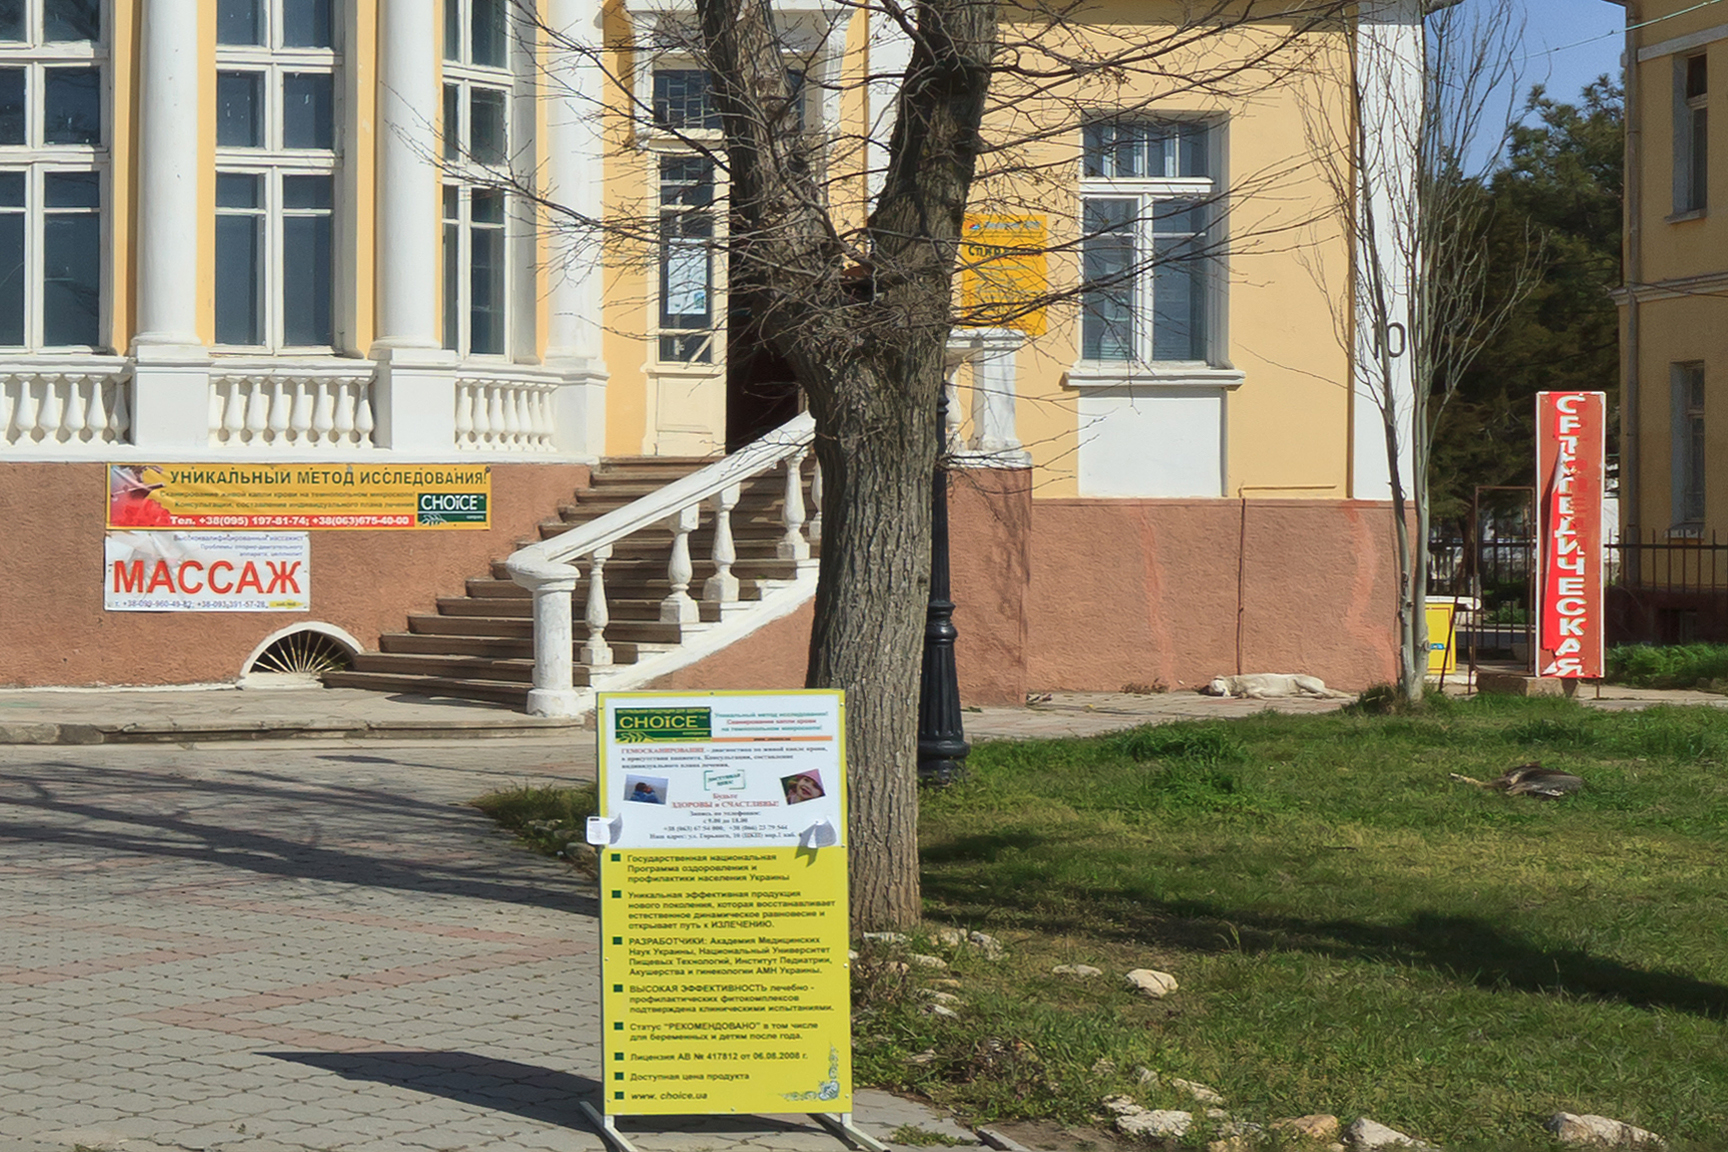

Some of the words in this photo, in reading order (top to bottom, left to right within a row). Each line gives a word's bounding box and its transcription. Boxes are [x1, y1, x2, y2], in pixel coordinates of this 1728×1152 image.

[298, 471, 355, 486] МЕТОД
[361, 471, 487, 486] ИССЛЕДОВАНИЯ!
[170, 516, 196, 524] Тел.
[199, 516, 248, 526] +38(095)
[114, 560, 302, 594] МАССАЖ
[628, 855, 707, 864] Государственная
[710, 854, 776, 862] национальная
[628, 865, 680, 873] Программа
[682, 865, 748, 873] оздоровления
[628, 875, 695, 884] профилактики
[749, 874, 790, 882] Украины
[711, 937, 756, 946] Академия
[629, 948, 650, 957] Наук
[653, 948, 696, 956] Украины,
[699, 947, 770, 955] Национальный
[772, 946, 830, 955] Университет
[629, 958, 673, 966] Пищевых
[629, 969, 685, 977] Акушерства
[629, 985, 678, 993] ВЫСОКАЯ
[681, 984, 768, 993] ЭФФЕКТИВНОСТЬ
[629, 996, 717, 1004] профилактических
[630, 1023, 661, 1032] Статус
[650, 1034, 708, 1042] беременных
[630, 1073, 680, 1082] Доступная
[707, 1074, 750, 1082] продукта
[660, 1092, 708, 1100] choice.ua
